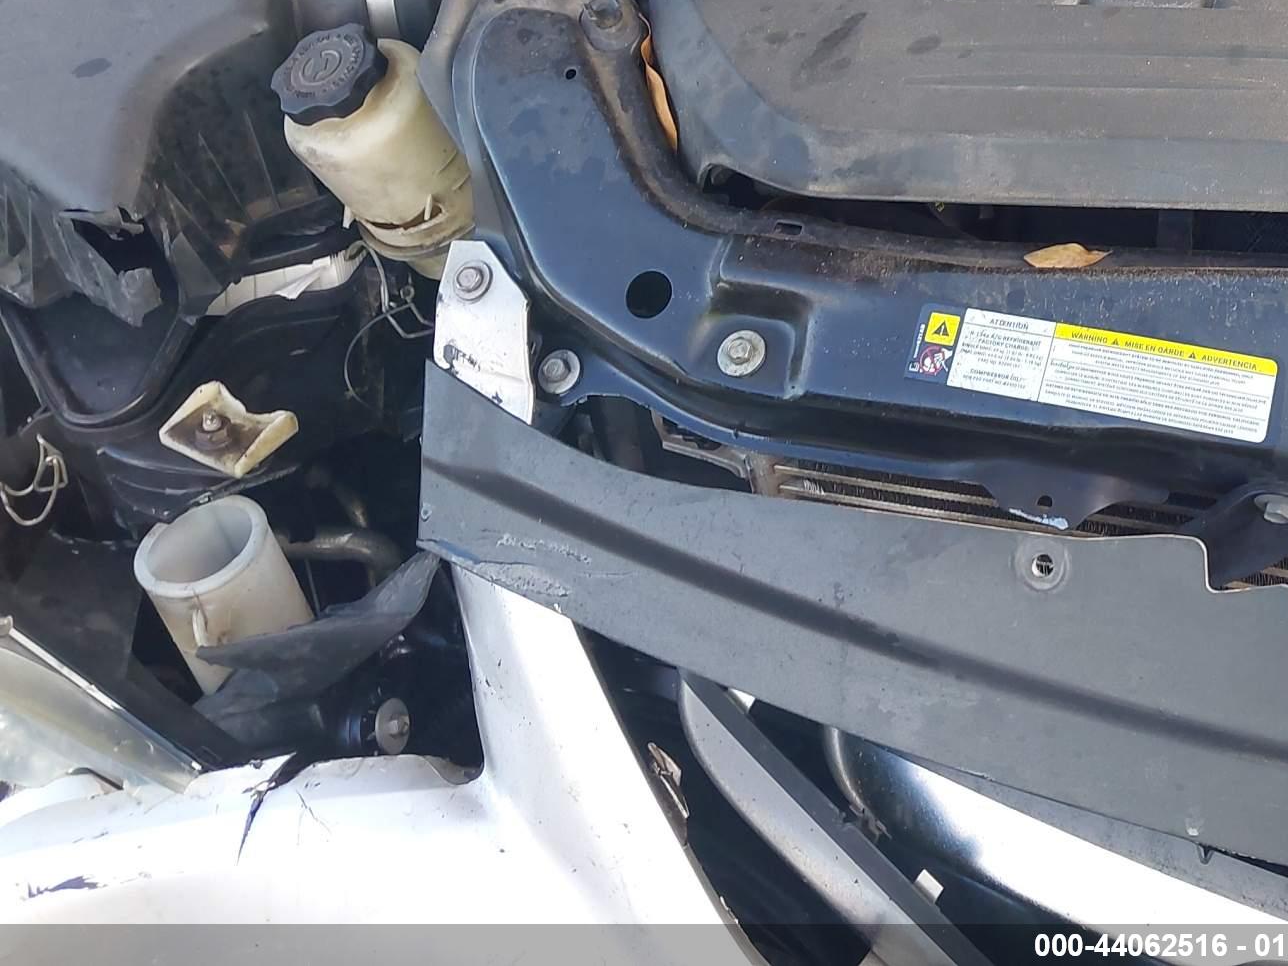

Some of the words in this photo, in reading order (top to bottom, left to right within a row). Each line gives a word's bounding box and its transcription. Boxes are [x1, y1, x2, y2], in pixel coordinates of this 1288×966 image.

[988, 317, 1029, 330] ATTENTION
[1070, 331, 1108, 344] WARNING
[1123, 340, 1144, 350] MISE
[1145, 343, 1157, 352] EN
[1157, 346, 1185, 357] GARDE
[1200, 353, 1257, 370] ADVERTENCIA
